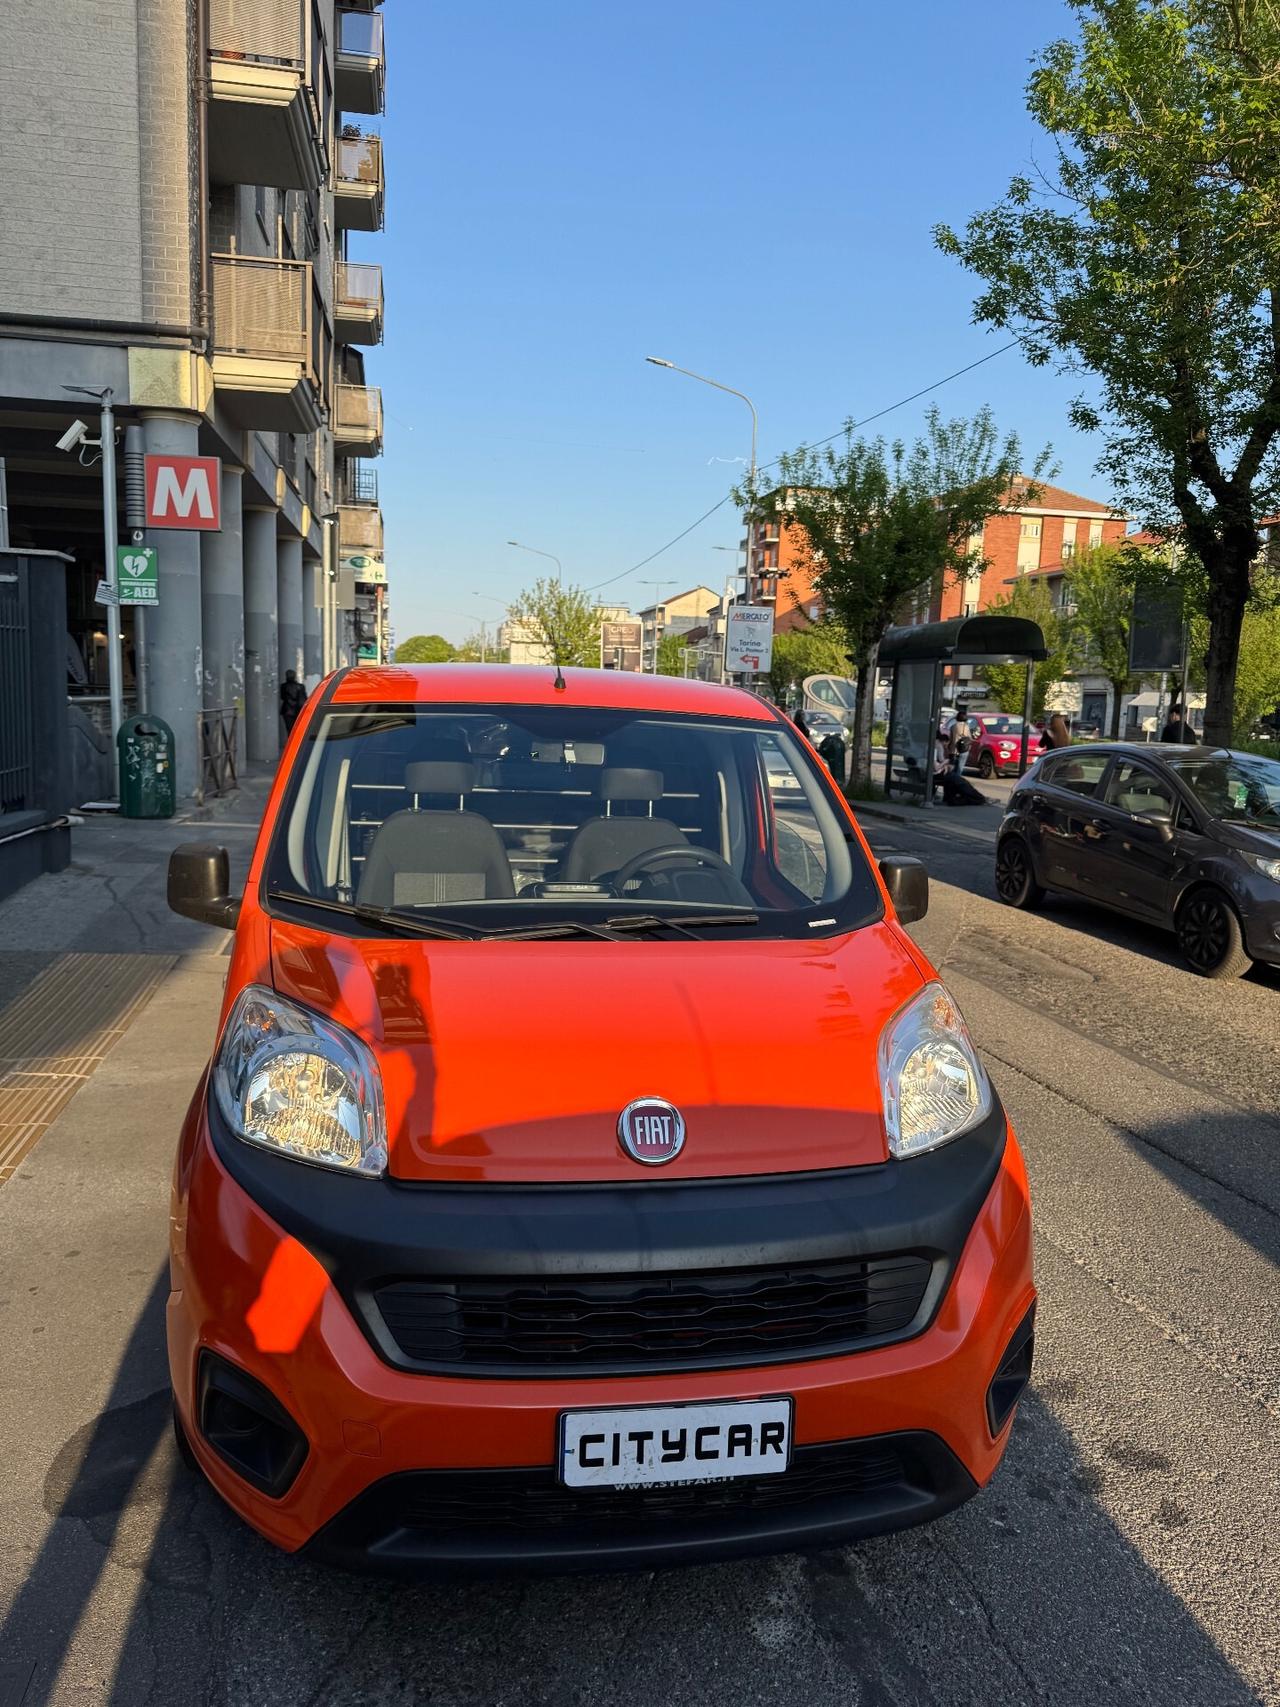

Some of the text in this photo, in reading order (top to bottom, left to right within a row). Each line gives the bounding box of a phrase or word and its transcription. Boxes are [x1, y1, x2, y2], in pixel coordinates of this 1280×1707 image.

[152, 466, 214, 519] M
[133, 587, 157, 598] AED
[739, 639, 761, 647] Torino
[635, 1116, 671, 1144] FIAT
[579, 1421, 785, 1468] CITYCAR
